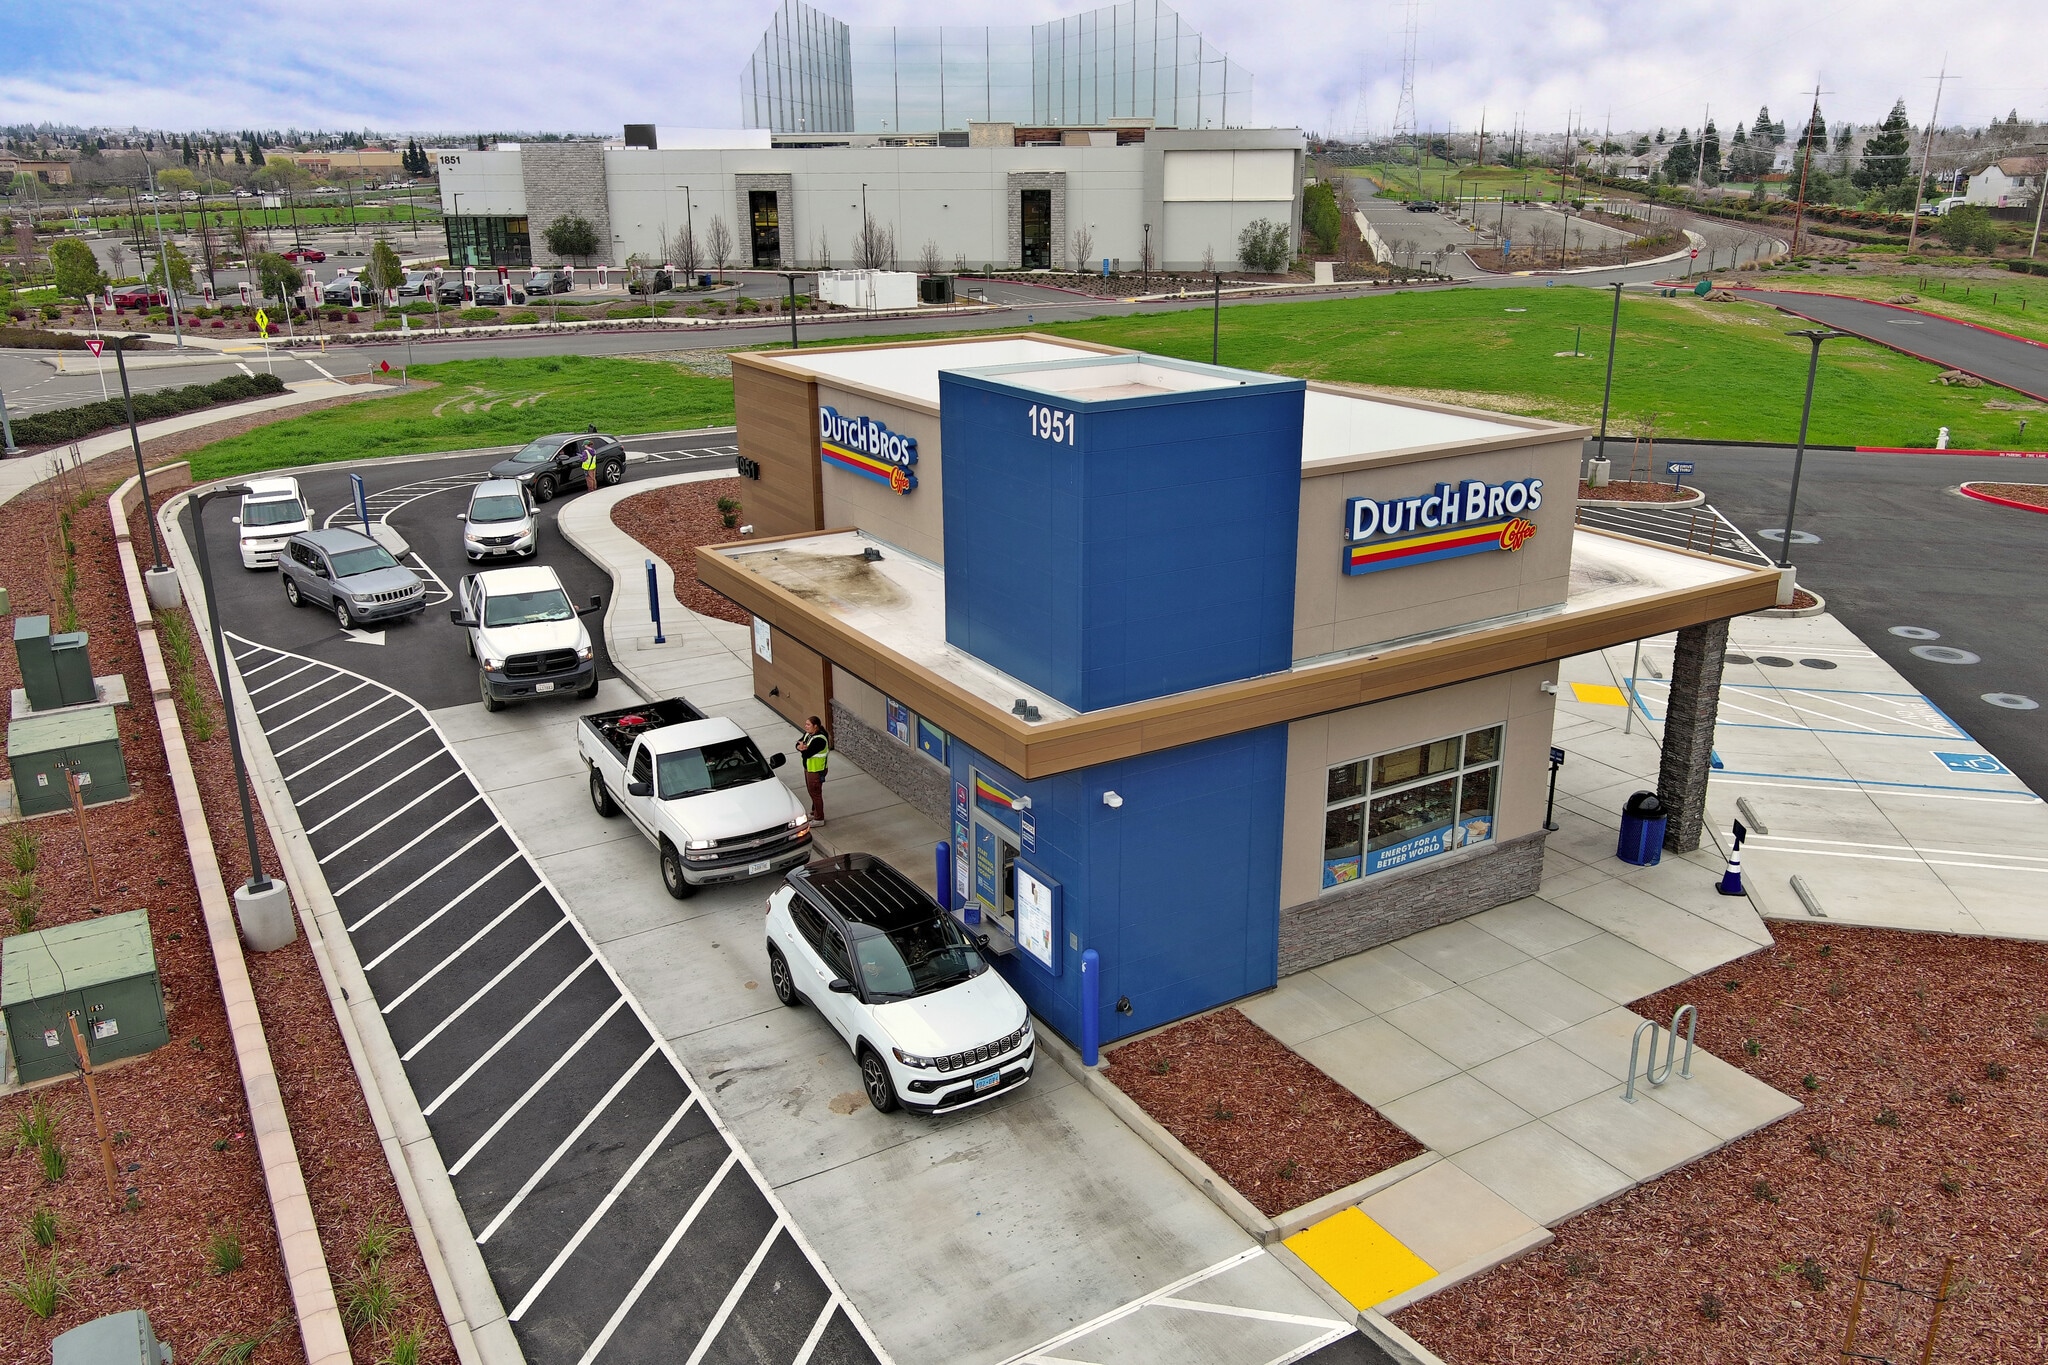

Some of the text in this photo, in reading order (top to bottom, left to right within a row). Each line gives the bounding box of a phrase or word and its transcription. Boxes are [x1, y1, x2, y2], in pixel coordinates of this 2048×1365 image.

[439, 155, 461, 165] 1851
[1028, 404, 1075, 446] 1951
[869, 421, 910, 466] BROS
[1465, 479, 1544, 522] BROS
[1499, 517, 1537, 552] Coffee
[1376, 843, 1440, 869] BETTER WORLD
[1380, 835, 1438, 859] ENERGY FOR A
